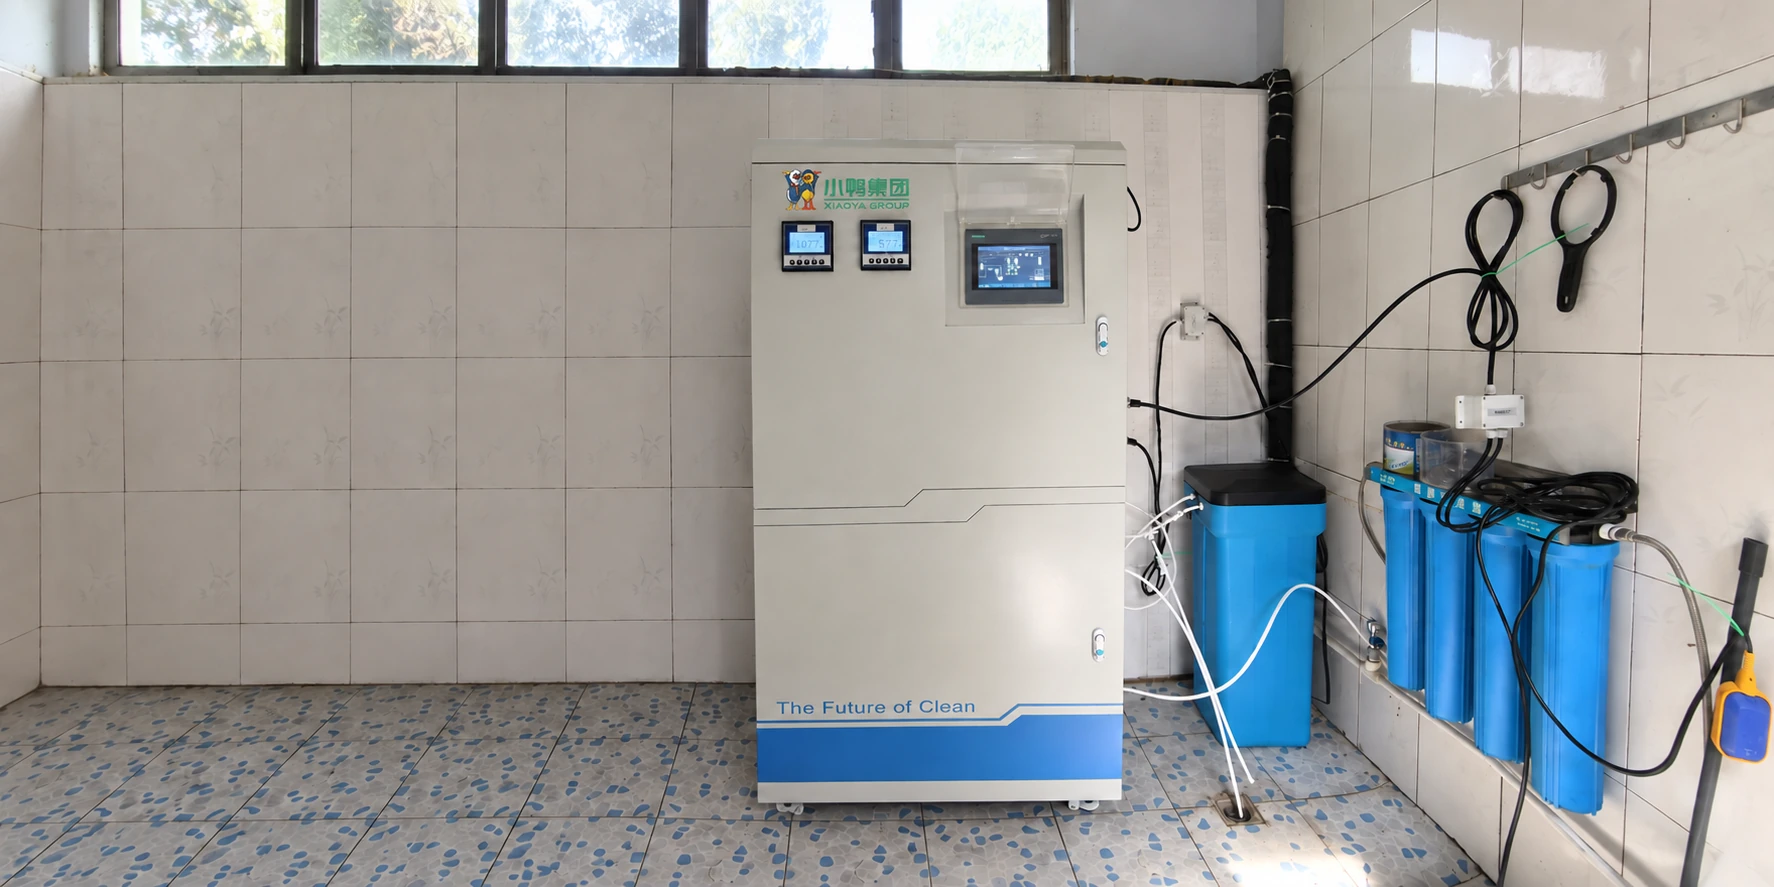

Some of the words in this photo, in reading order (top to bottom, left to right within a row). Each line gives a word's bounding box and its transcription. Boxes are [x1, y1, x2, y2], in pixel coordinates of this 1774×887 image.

[824, 178, 910, 197] 小鸭集团
[824, 202, 866, 210] XIAOYA
[869, 202, 910, 210] GROUP
[776, 701, 815, 715] The
[822, 701, 886, 715] Future
[893, 700, 912, 714] of
[919, 700, 976, 713] Clean
